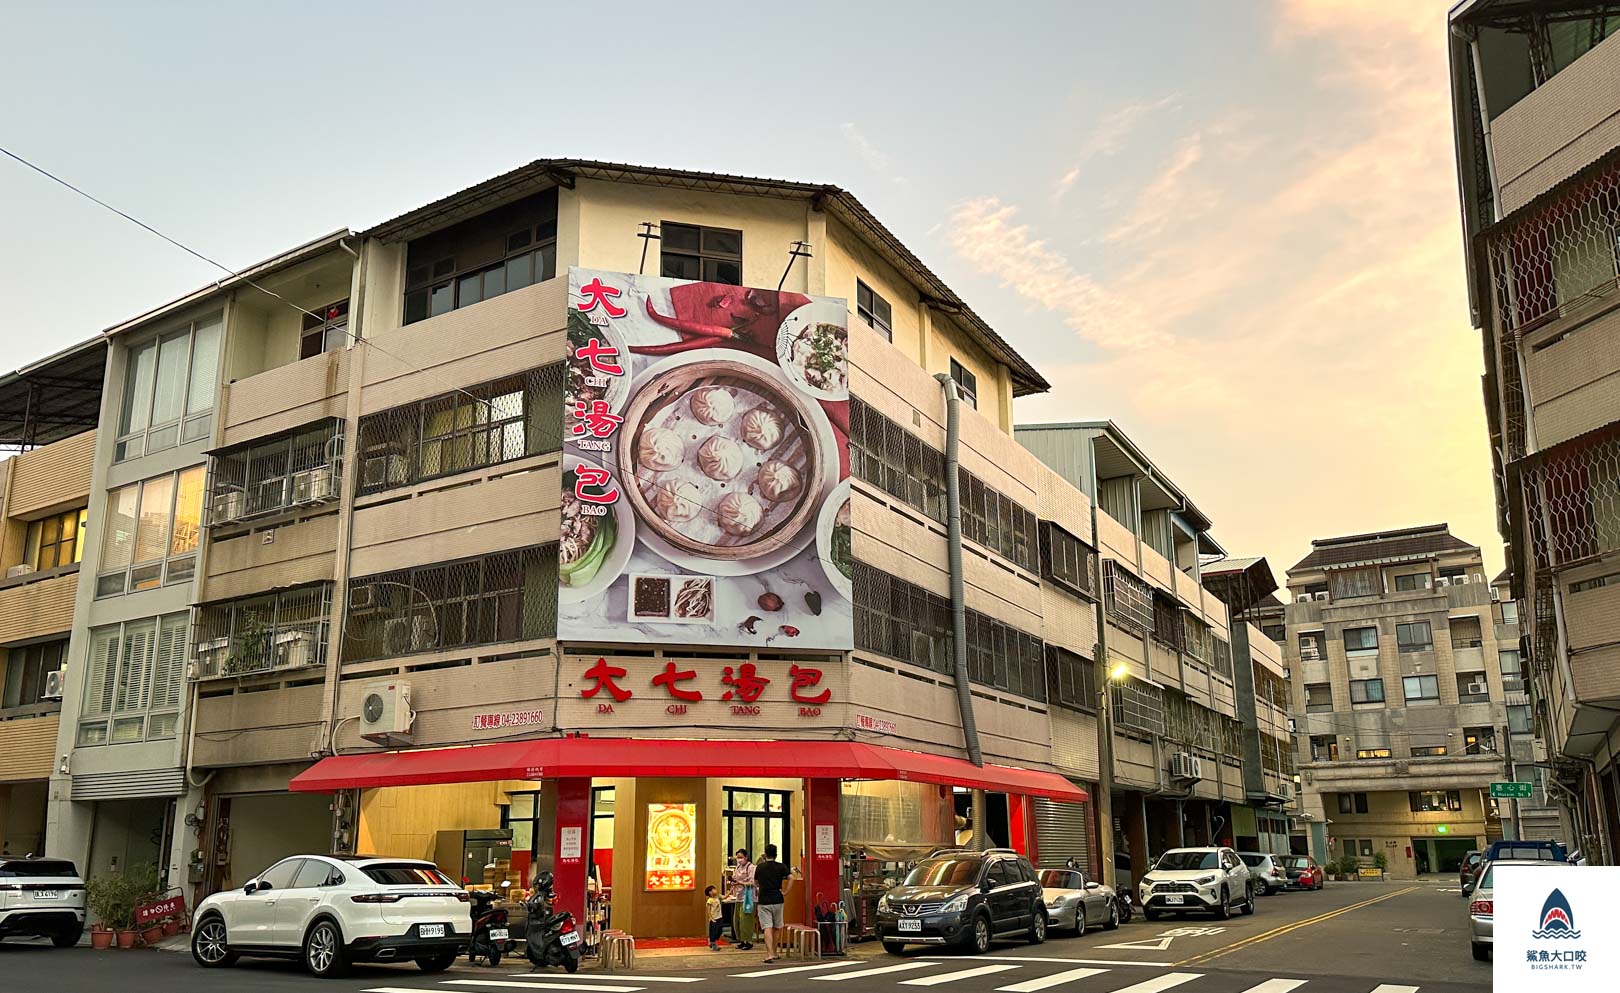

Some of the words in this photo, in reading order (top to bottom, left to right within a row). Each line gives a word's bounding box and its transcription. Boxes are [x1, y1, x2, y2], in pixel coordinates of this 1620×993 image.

[590, 315, 609, 326] DA
[584, 376, 608, 388] CHI
[573, 277, 627, 505] 大七湯包
[578, 439, 611, 453] TANG
[581, 504, 608, 516] BAO
[580, 656, 832, 705] 大七湯包
[598, 703, 614, 713] DA
[666, 704, 687, 715] CHI
[731, 705, 761, 716] TANG
[799, 707, 821, 717] BAO
[501, 709, 543, 726] 04-23891660
